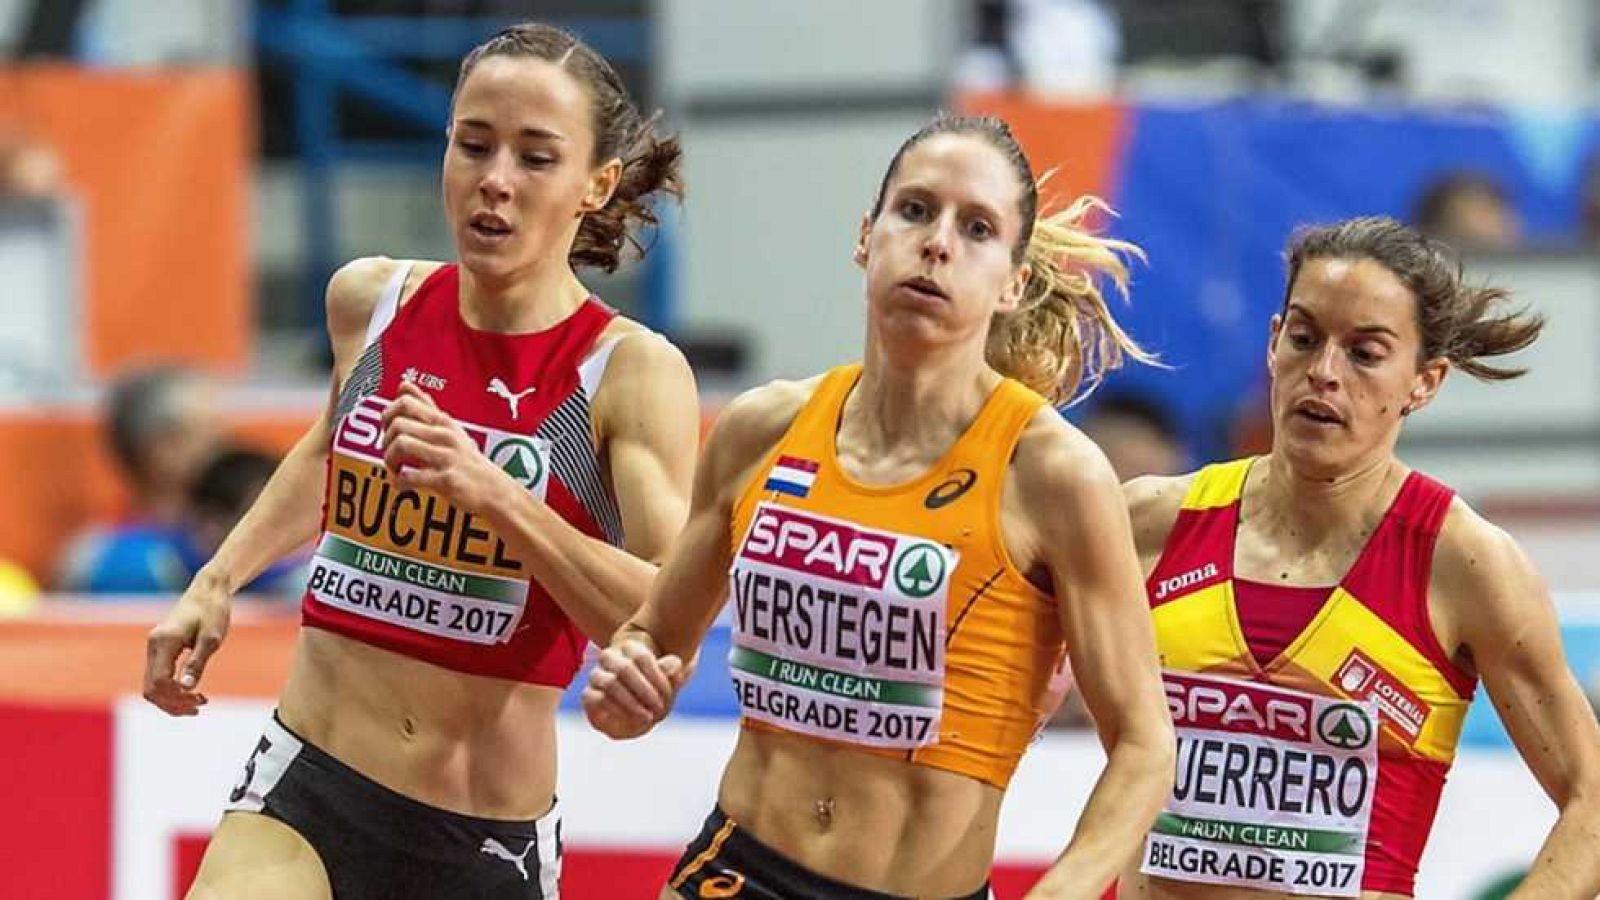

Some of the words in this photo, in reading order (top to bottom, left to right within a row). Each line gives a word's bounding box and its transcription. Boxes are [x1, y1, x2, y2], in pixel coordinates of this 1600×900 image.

[361, 553, 400, 578] RUN
[405, 567, 467, 593] CLEAN
[747, 515, 889, 581] SPAR
[309, 566, 440, 624] BELGRADE
[450, 604, 514, 637] 2017
[734, 568, 937, 671] VERSTEGEN
[780, 665, 818, 690] RUN
[822, 673, 881, 698] CLEAN
[867, 711, 933, 741] 2017
[1164, 682, 1308, 737] SPAR
[1173, 737, 1368, 818] UERRERO
[1190, 821, 1235, 841] RUN
[1240, 826, 1308, 849] CLEAN
[1149, 841, 1285, 883] BELGRADE
[1293, 859, 1358, 889] 2017
